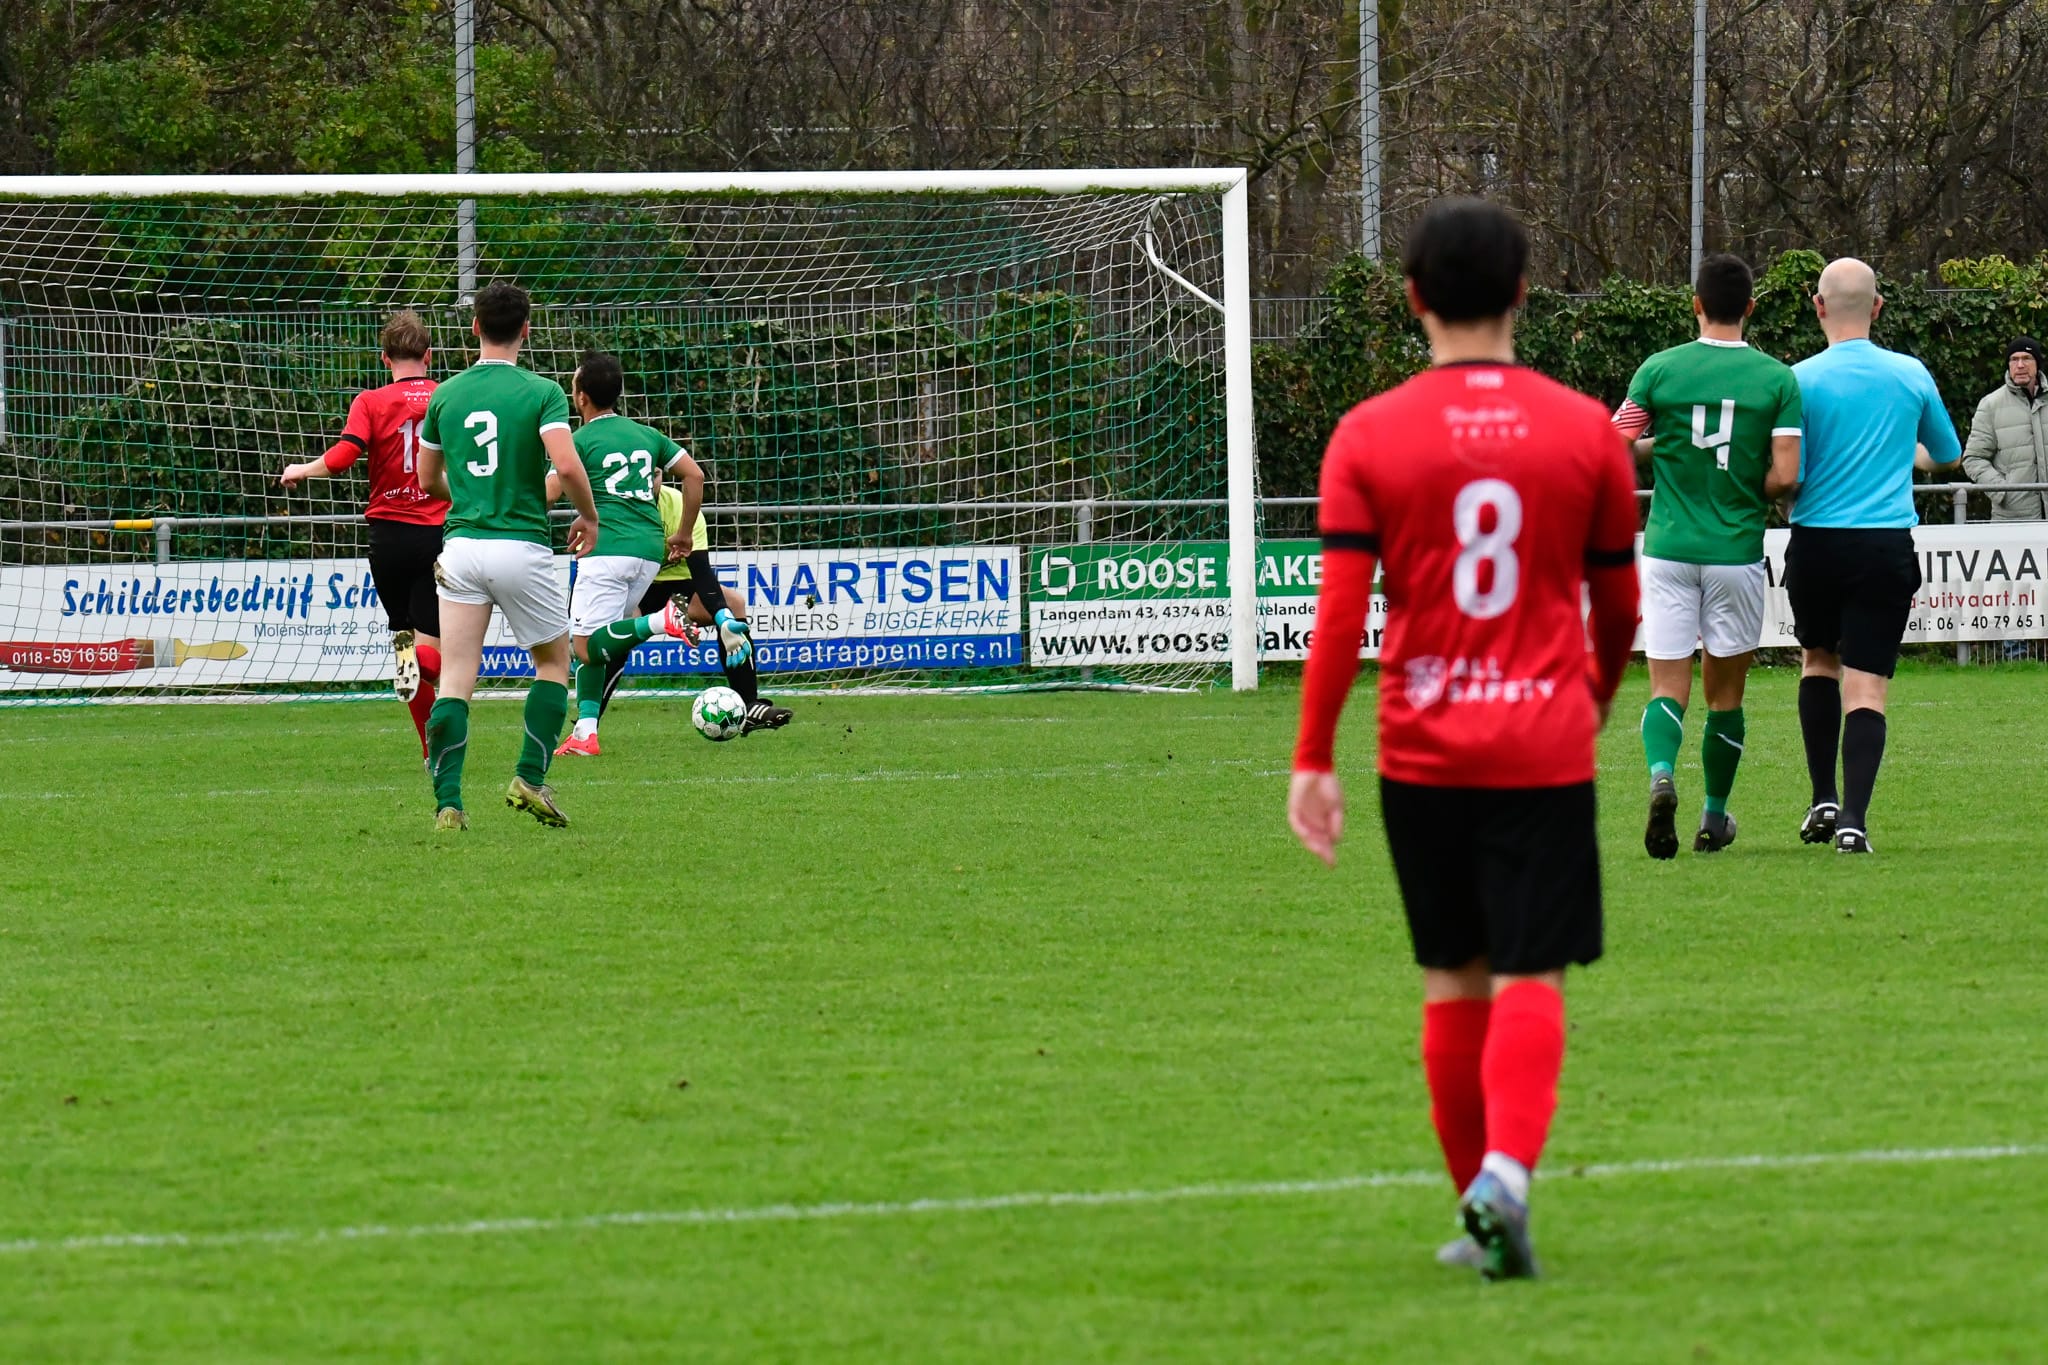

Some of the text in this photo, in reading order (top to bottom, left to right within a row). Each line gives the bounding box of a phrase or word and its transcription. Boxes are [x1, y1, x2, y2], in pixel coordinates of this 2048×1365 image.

[398, 419, 424, 473] 1
[464, 410, 498, 477] 3
[1691, 399, 1735, 471] 4
[602, 449, 653, 501] 23
[1453, 478, 1523, 620] 8
[1914, 548, 2048, 583] ITVAA
[1098, 557, 1217, 590] ROOSE
[61, 572, 313, 619] Schildersbedrijf
[254, 622, 337, 638] Molenstraat
[341, 621, 358, 635] 22
[863, 609, 1010, 630] BIGGEKERKE
[1040, 606, 1131, 623] Langendam
[1162, 605, 1200, 618] 4374
[1204, 604, 1225, 617] AB
[1908, 617, 1931, 631] el.:
[1937, 616, 1954, 630] 06
[1971, 615, 1989, 629] 40
[1994, 615, 2010, 628] 79
[2016, 614, 2033, 628] 65
[76, 647, 95, 663] 16
[99, 647, 118, 662] 58
